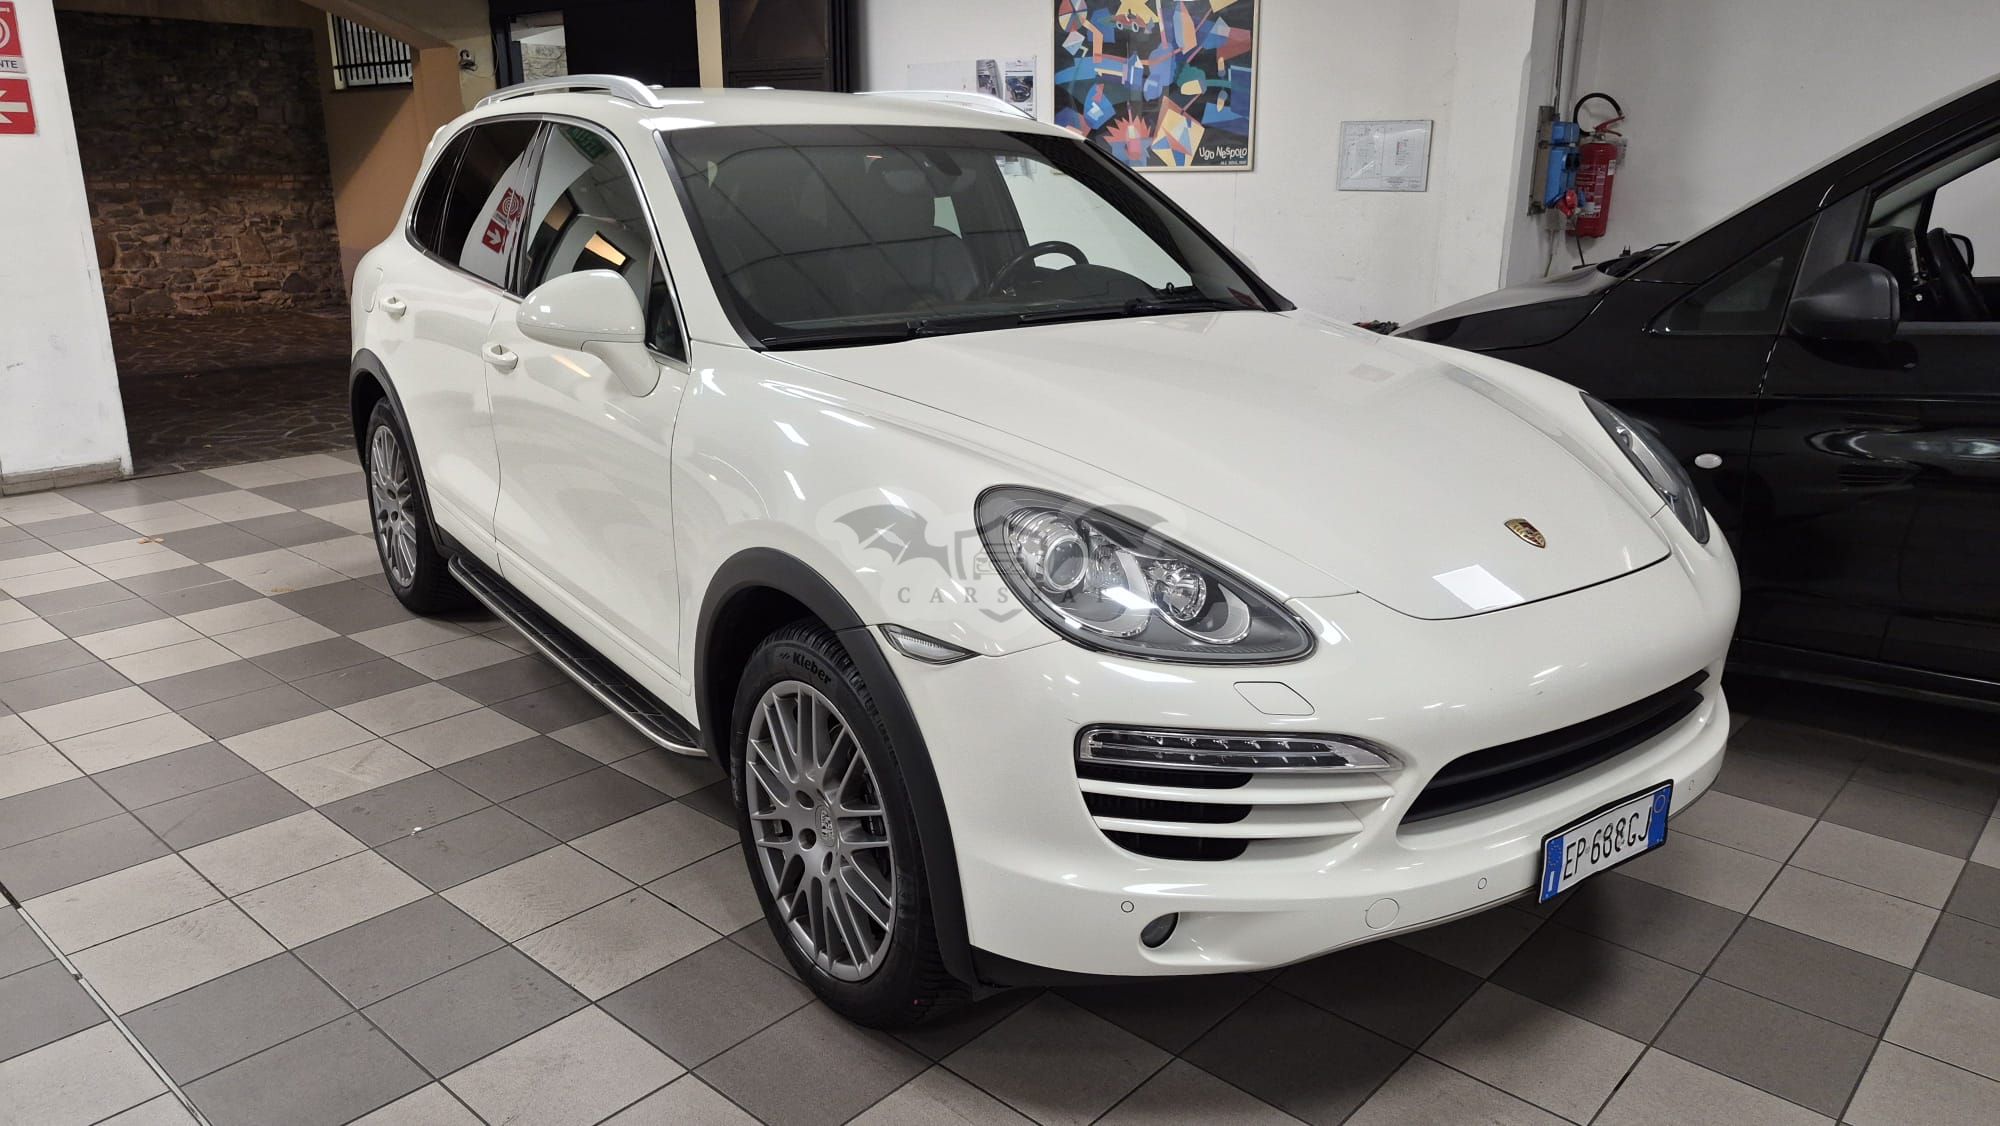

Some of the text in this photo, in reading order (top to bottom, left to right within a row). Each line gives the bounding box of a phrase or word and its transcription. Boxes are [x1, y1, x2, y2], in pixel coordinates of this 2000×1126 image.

[1199, 147, 1215, 160] Ugo
[792, 652, 832, 684] Kleber
[1563, 806, 1652, 881] EP 688GJ
